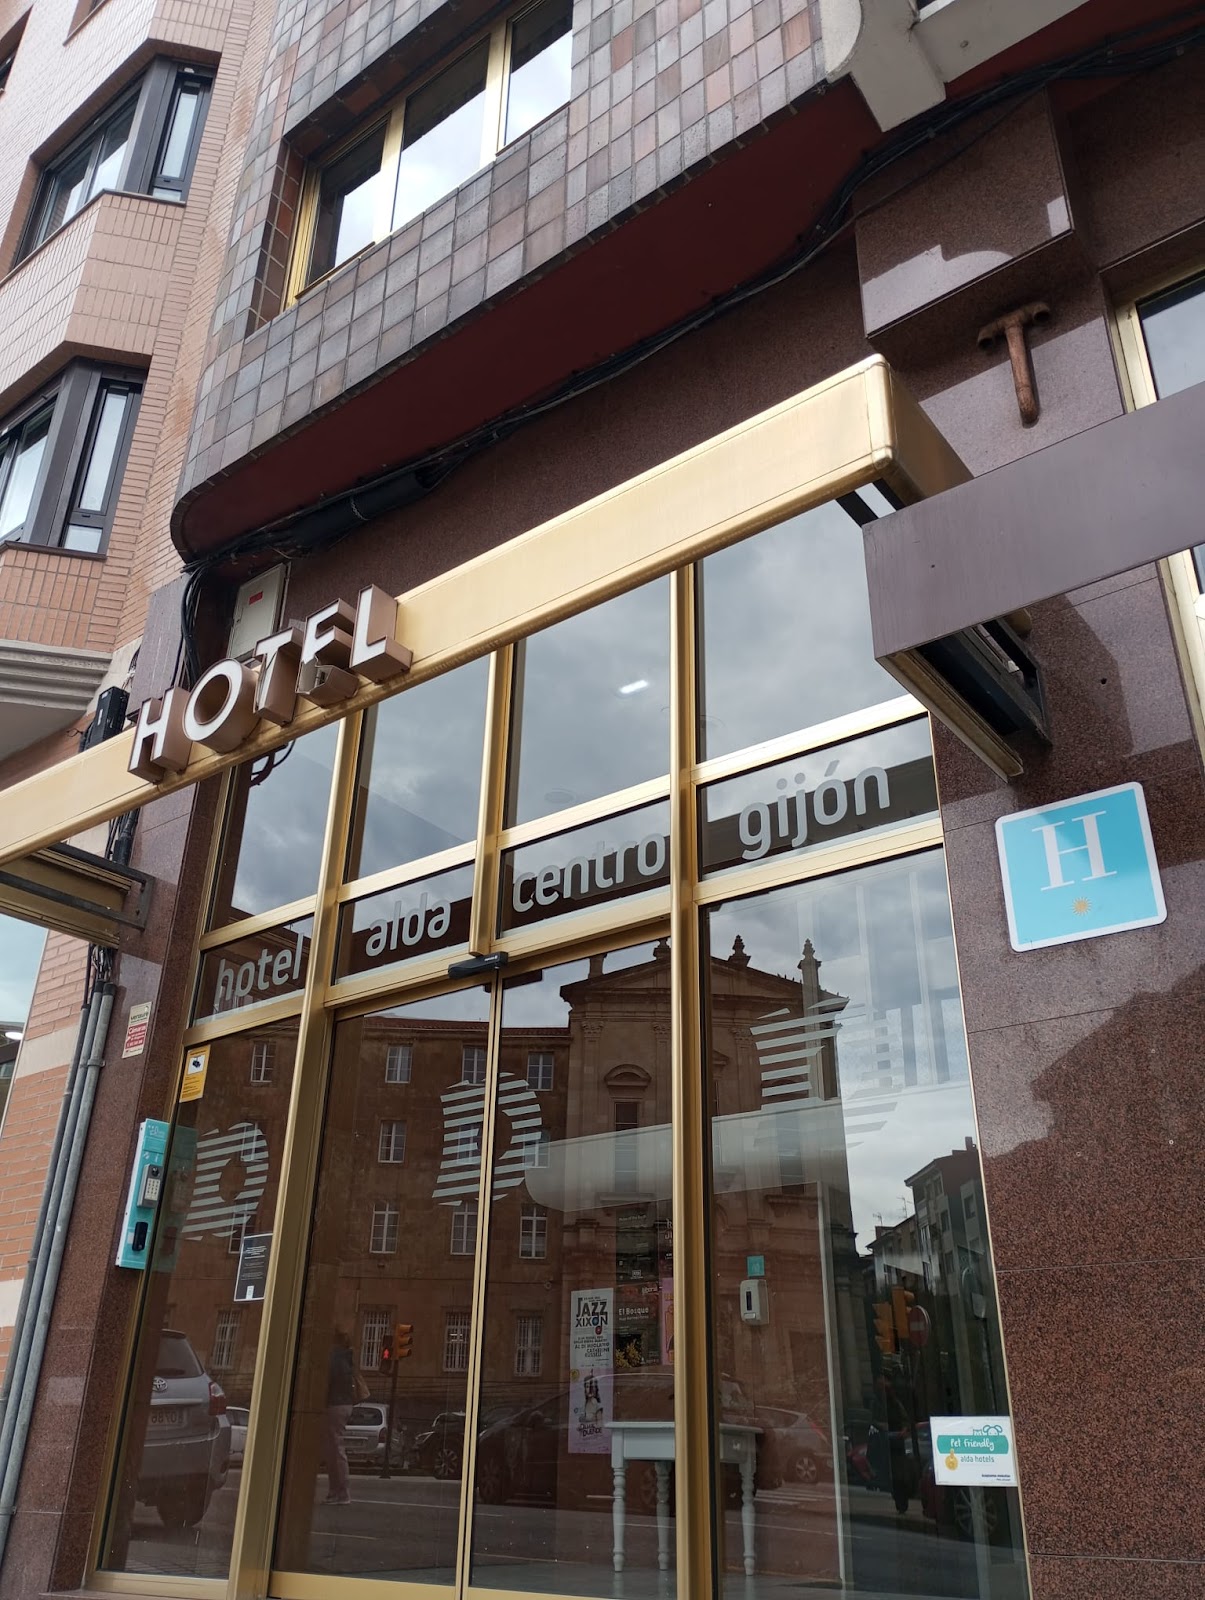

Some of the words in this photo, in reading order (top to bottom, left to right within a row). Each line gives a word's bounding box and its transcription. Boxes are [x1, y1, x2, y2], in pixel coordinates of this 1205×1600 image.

[128, 584, 398, 776] HOTEL
[1031, 810, 1117, 891] H
[215, 932, 304, 1006] hotel
[366, 892, 450, 957] alda
[513, 833, 666, 913] centro
[739, 759, 890, 860] gijón
[576, 1297, 608, 1318] JAZZ
[951, 1438, 961, 1447] Pet
[960, 1455, 974, 1463] alda
[975, 1455, 995, 1463] hotels
